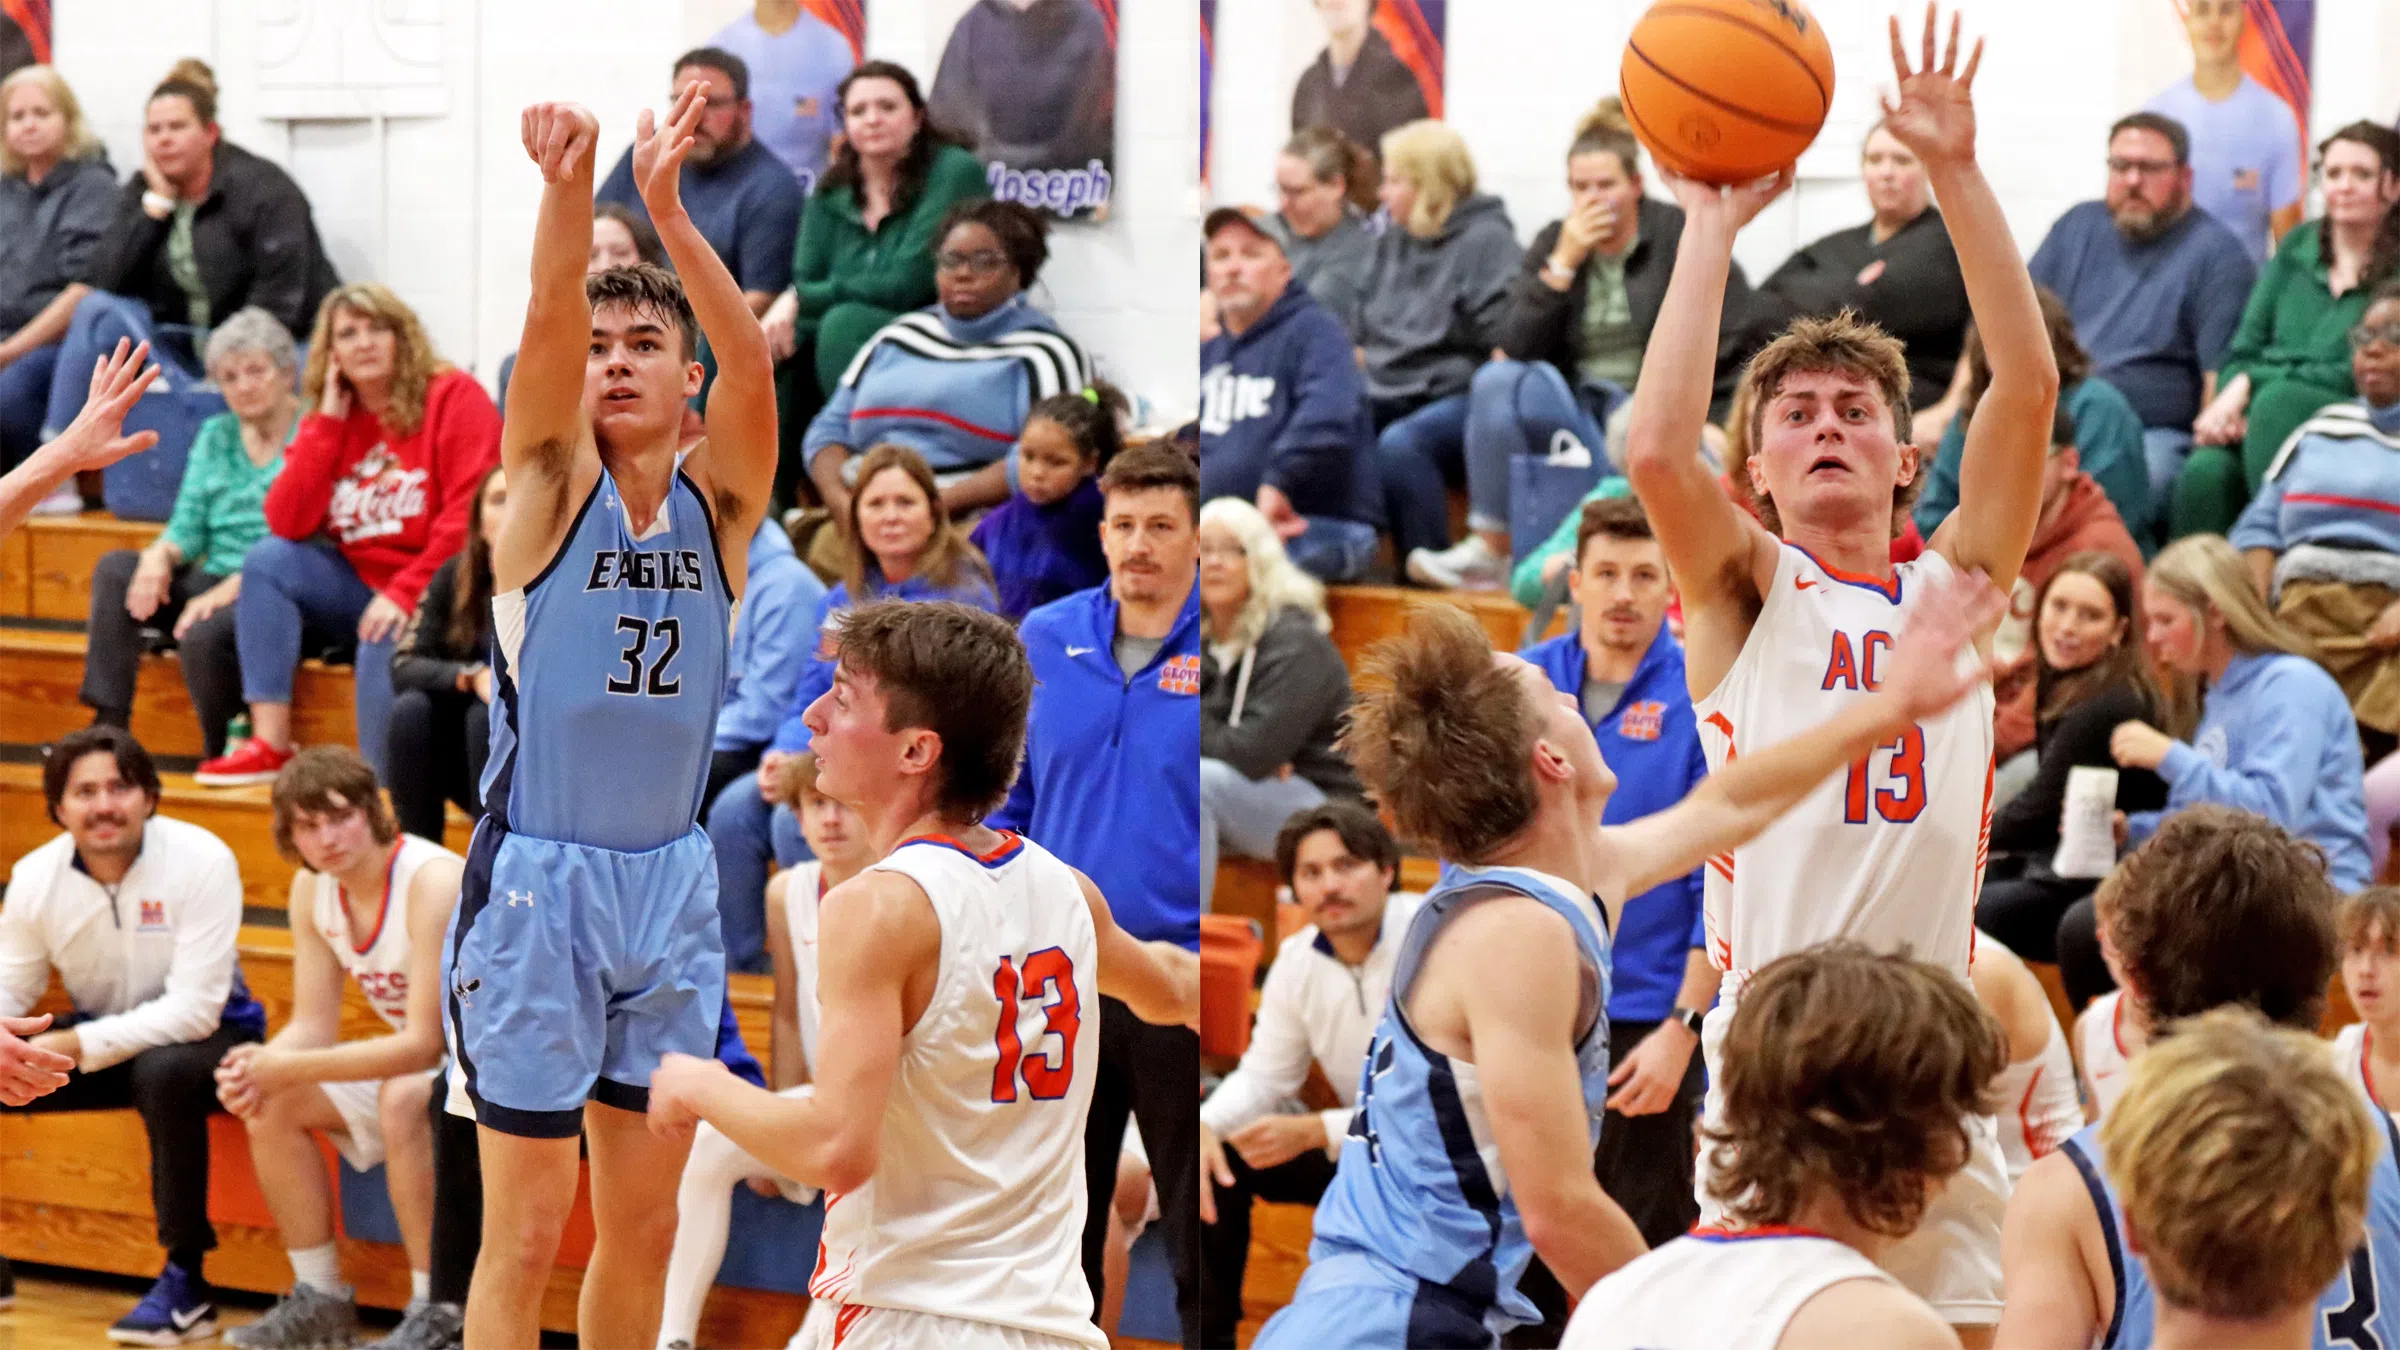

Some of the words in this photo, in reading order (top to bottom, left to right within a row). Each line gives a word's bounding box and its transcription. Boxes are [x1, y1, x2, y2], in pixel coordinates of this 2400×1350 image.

[986, 158, 1112, 218] Joseph
[583, 550, 703, 593] EAGLES
[606, 613, 682, 698] 32
[1844, 724, 1928, 825] 13
[990, 945, 1082, 1104] 13
